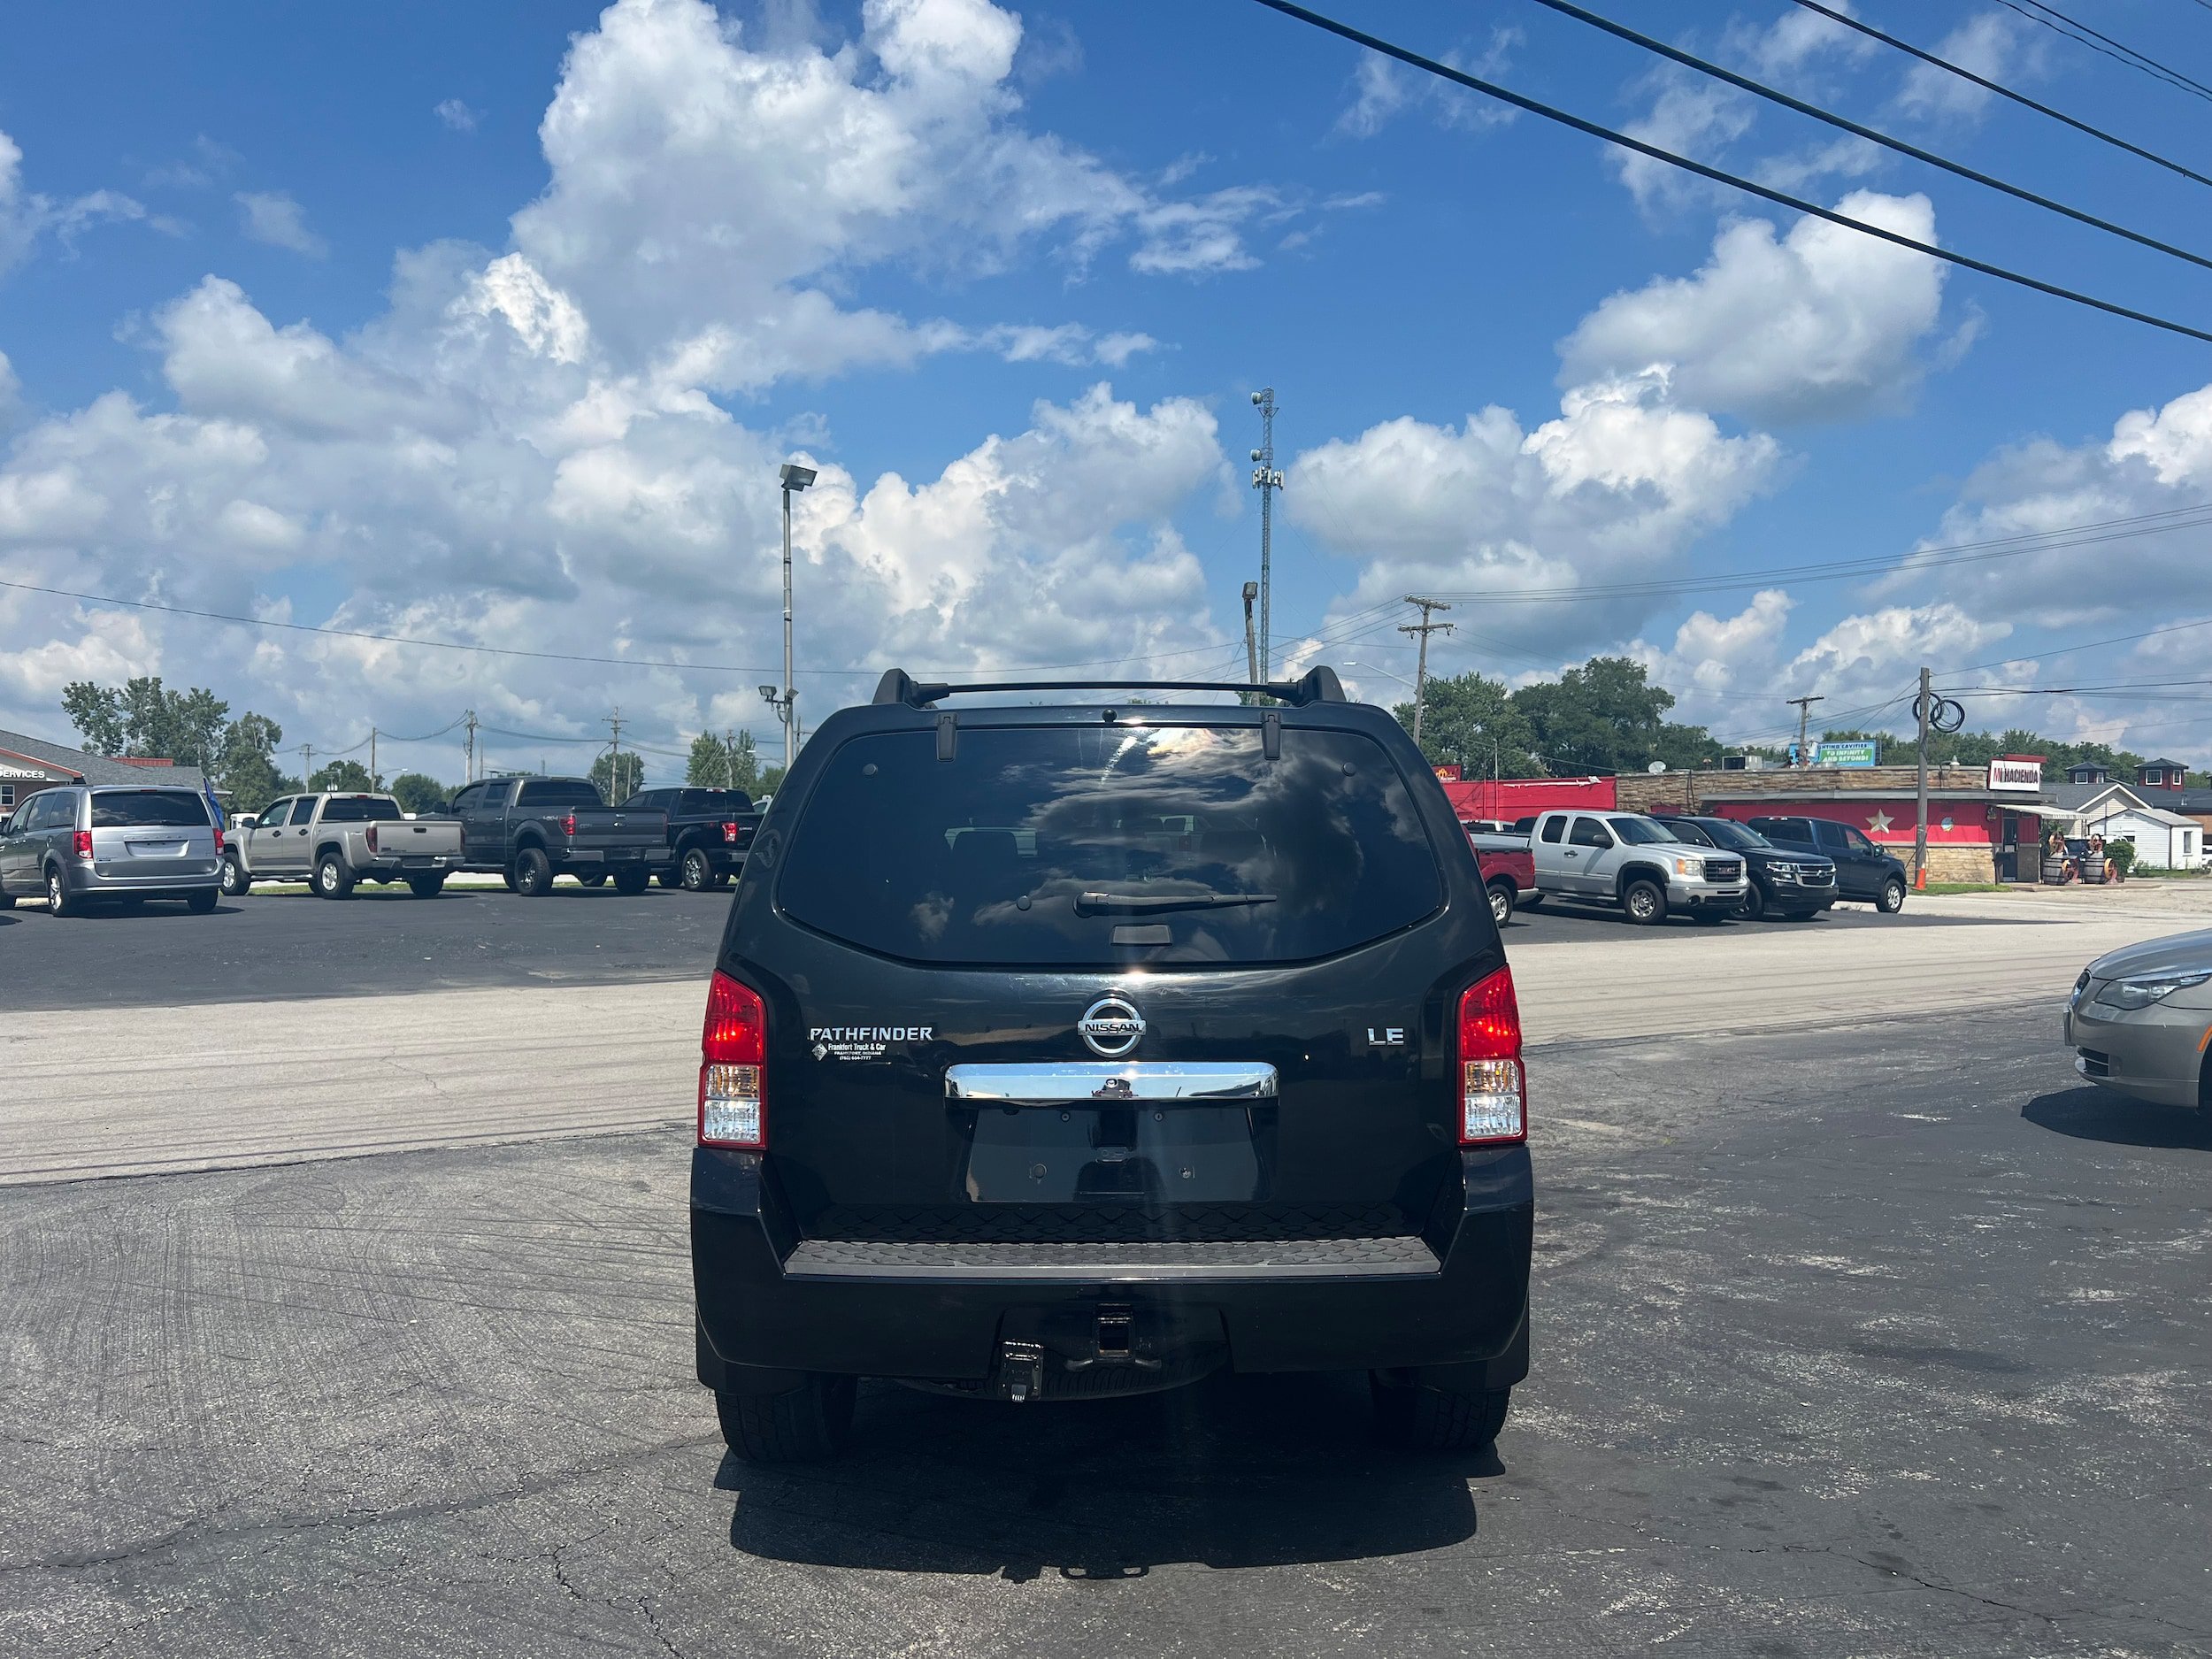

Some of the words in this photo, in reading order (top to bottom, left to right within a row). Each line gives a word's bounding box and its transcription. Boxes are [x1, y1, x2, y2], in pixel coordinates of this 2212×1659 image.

[1993, 767, 2002, 782] MI
[2004, 768, 2039, 784] HACIENDA
[810, 1027, 933, 1041] PATHFINDER
[1085, 1023, 1140, 1033] NISSAN
[1367, 1028, 1404, 1045] LE
[827, 1042, 853, 1051] Frankfort
[853, 1042, 870, 1051] Truck
[875, 1042, 887, 1051] Car
